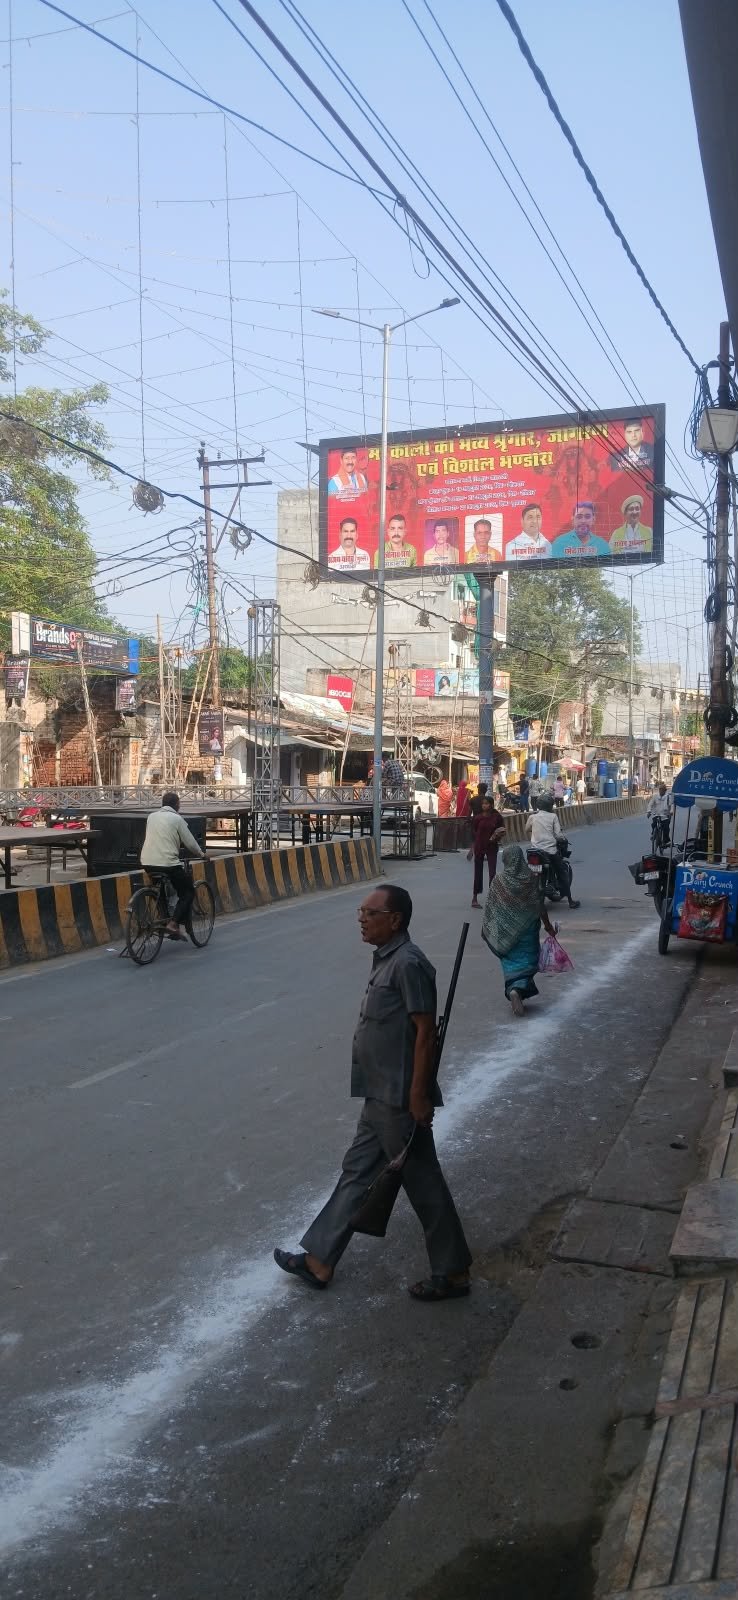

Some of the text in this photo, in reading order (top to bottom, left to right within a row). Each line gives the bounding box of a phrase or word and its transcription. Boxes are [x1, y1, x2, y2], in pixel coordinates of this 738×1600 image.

[390, 440, 430, 459] काली
[434, 439, 454, 455] का
[458, 435, 490, 452] भव्य
[416, 458, 439, 477] एवं
[442, 455, 495, 475] विशाल
[687, 769, 714, 785] Dairy
[680, 868, 707, 889] Dairy
[709, 875, 734, 889] Crunch
